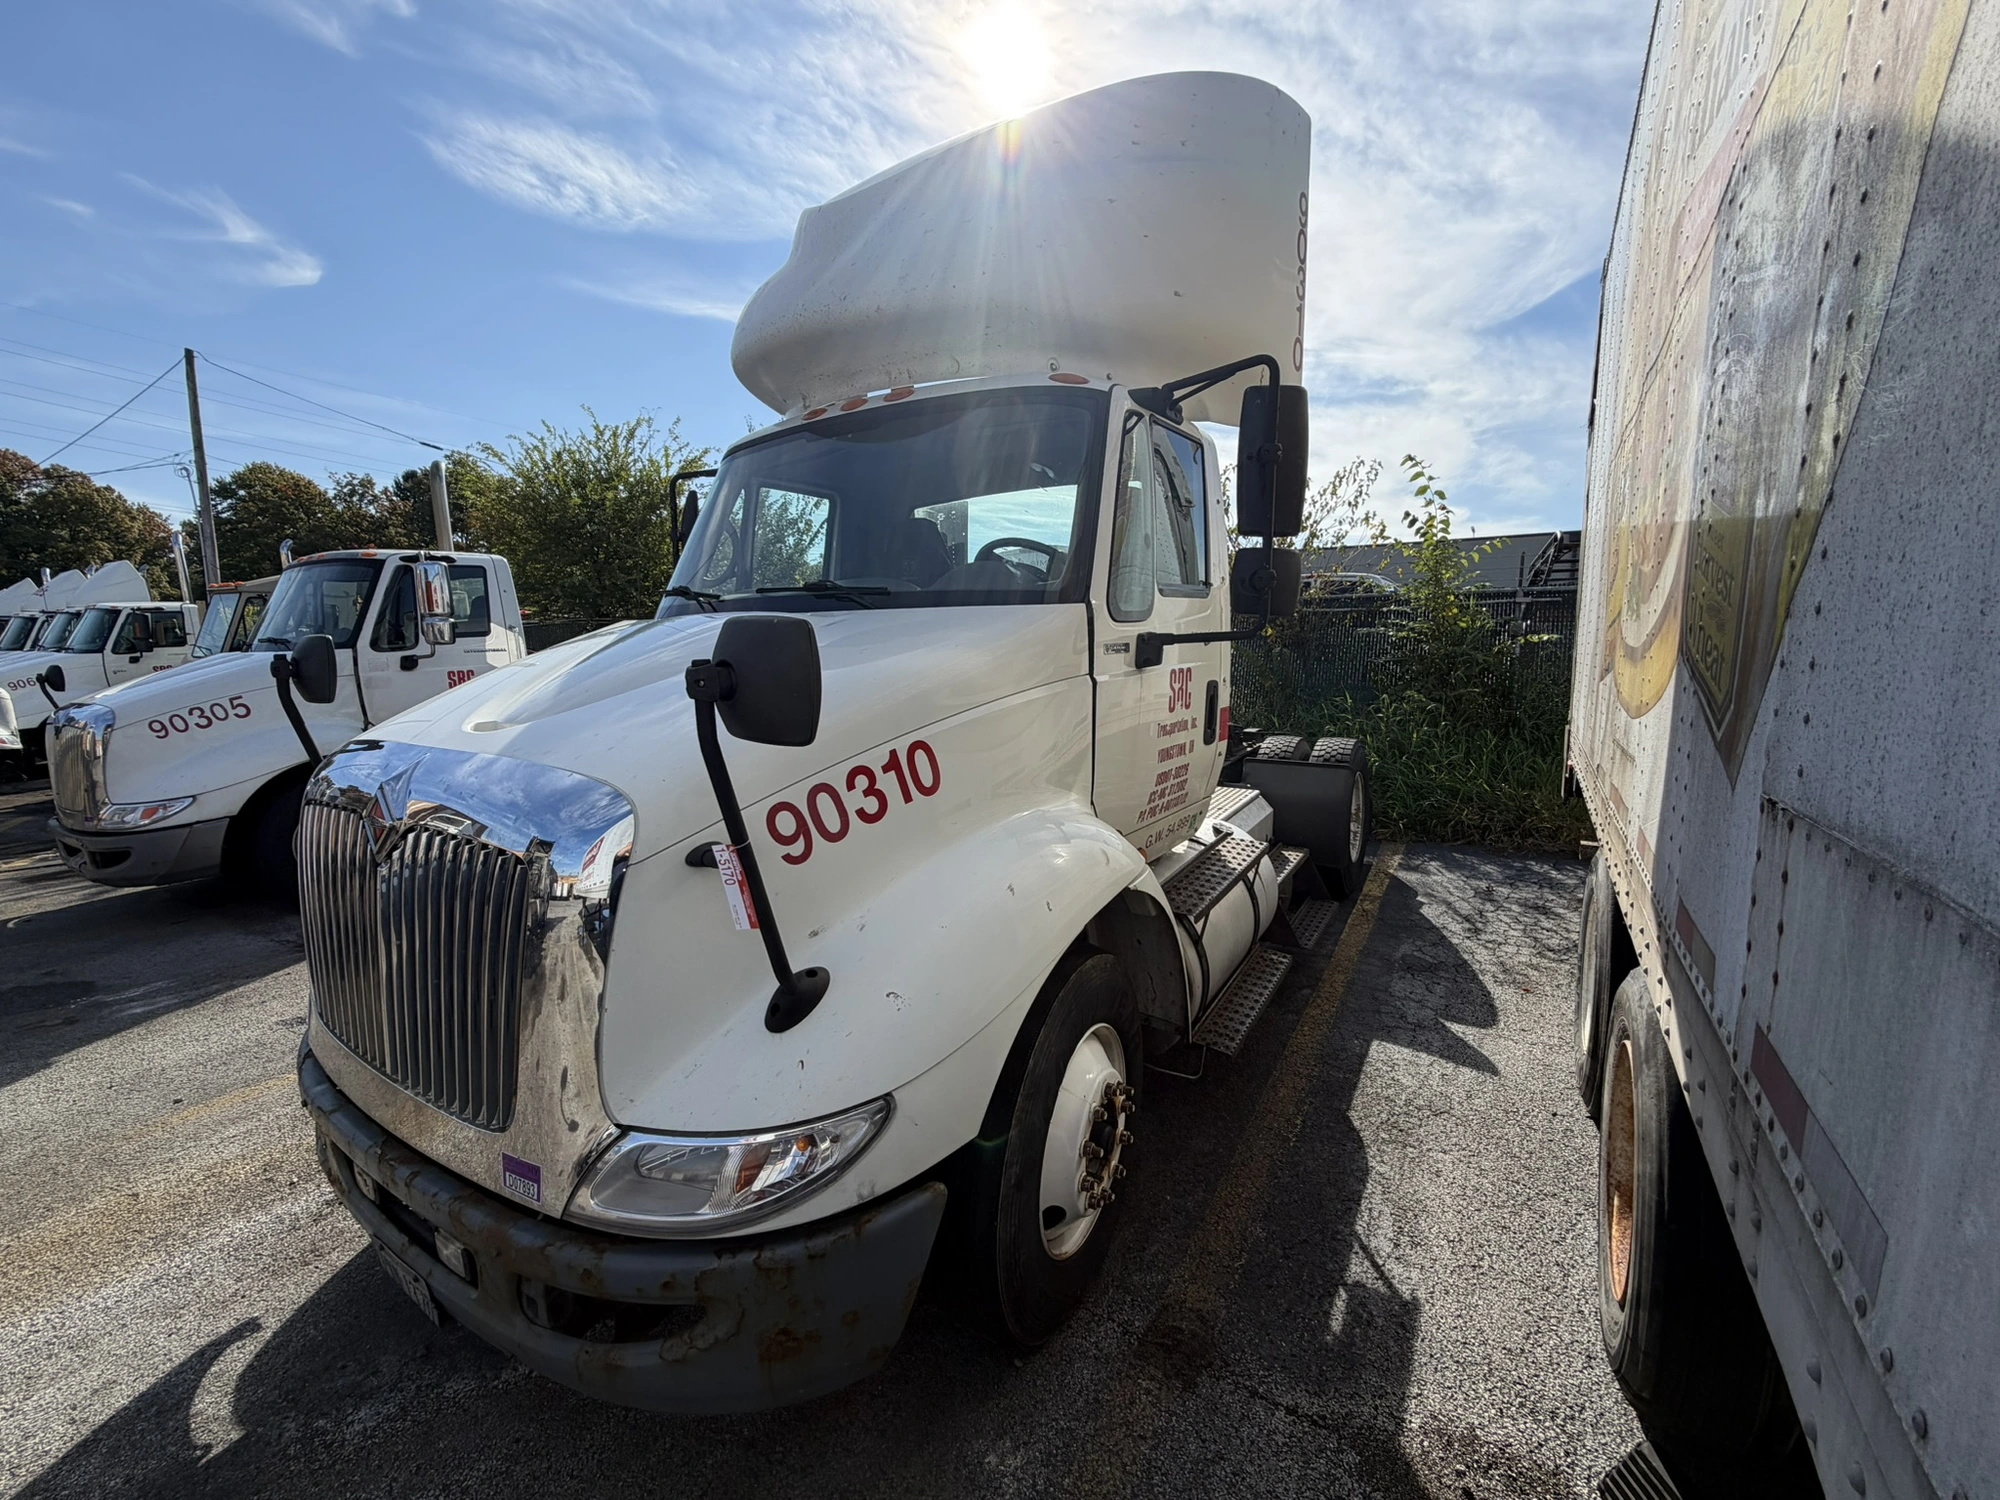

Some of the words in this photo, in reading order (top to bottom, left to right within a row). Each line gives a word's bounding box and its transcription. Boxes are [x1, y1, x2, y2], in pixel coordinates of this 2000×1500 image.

[1293, 191, 1309, 373] 90310
[147, 694, 252, 740] 90305
[766, 739, 942, 866] 90310
[715, 847, 737, 886] 1-5170
[508, 1174, 536, 1198] D07893
